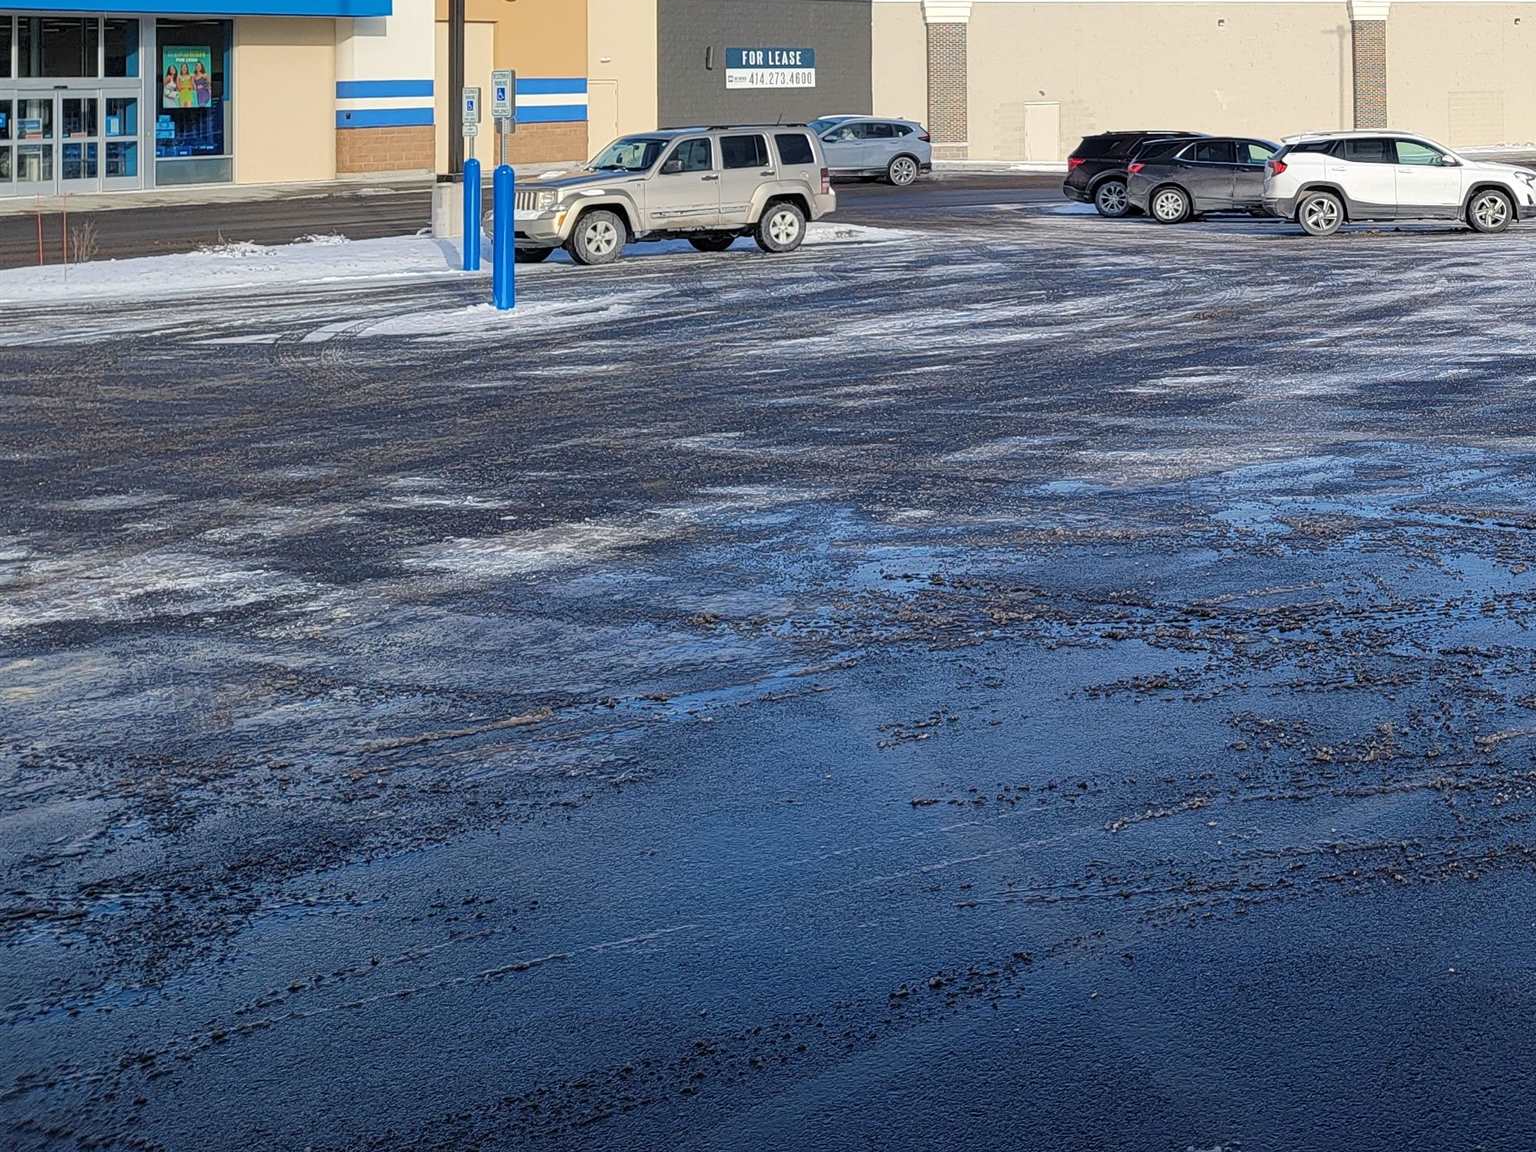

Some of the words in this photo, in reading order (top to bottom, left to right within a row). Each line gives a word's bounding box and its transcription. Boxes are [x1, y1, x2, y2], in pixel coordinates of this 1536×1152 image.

[742, 51, 763, 65] FOR
[768, 51, 802, 65] LEASE
[749, 71, 812, 86] 414.273.4600
